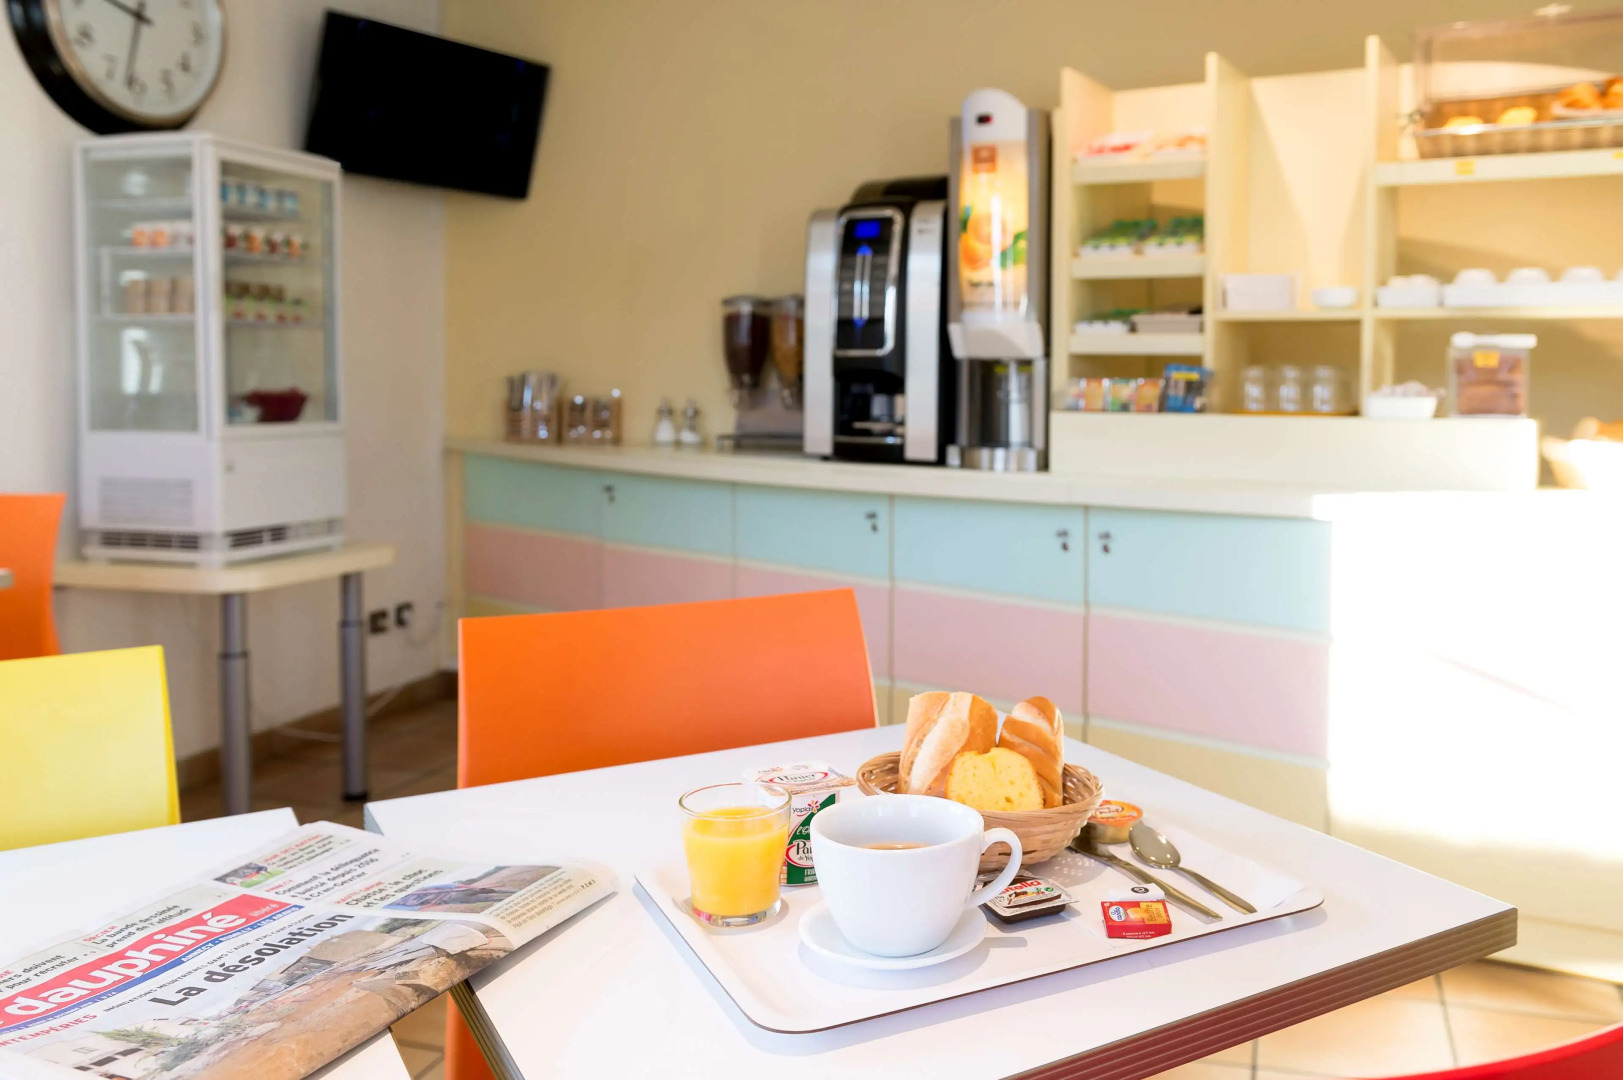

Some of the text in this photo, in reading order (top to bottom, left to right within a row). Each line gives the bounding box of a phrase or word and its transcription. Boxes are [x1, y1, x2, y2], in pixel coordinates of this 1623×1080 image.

[1001, 879, 1042, 895] utella
[4, 910, 247, 1017] dauphiné
[148, 913, 356, 1007] La désolation
